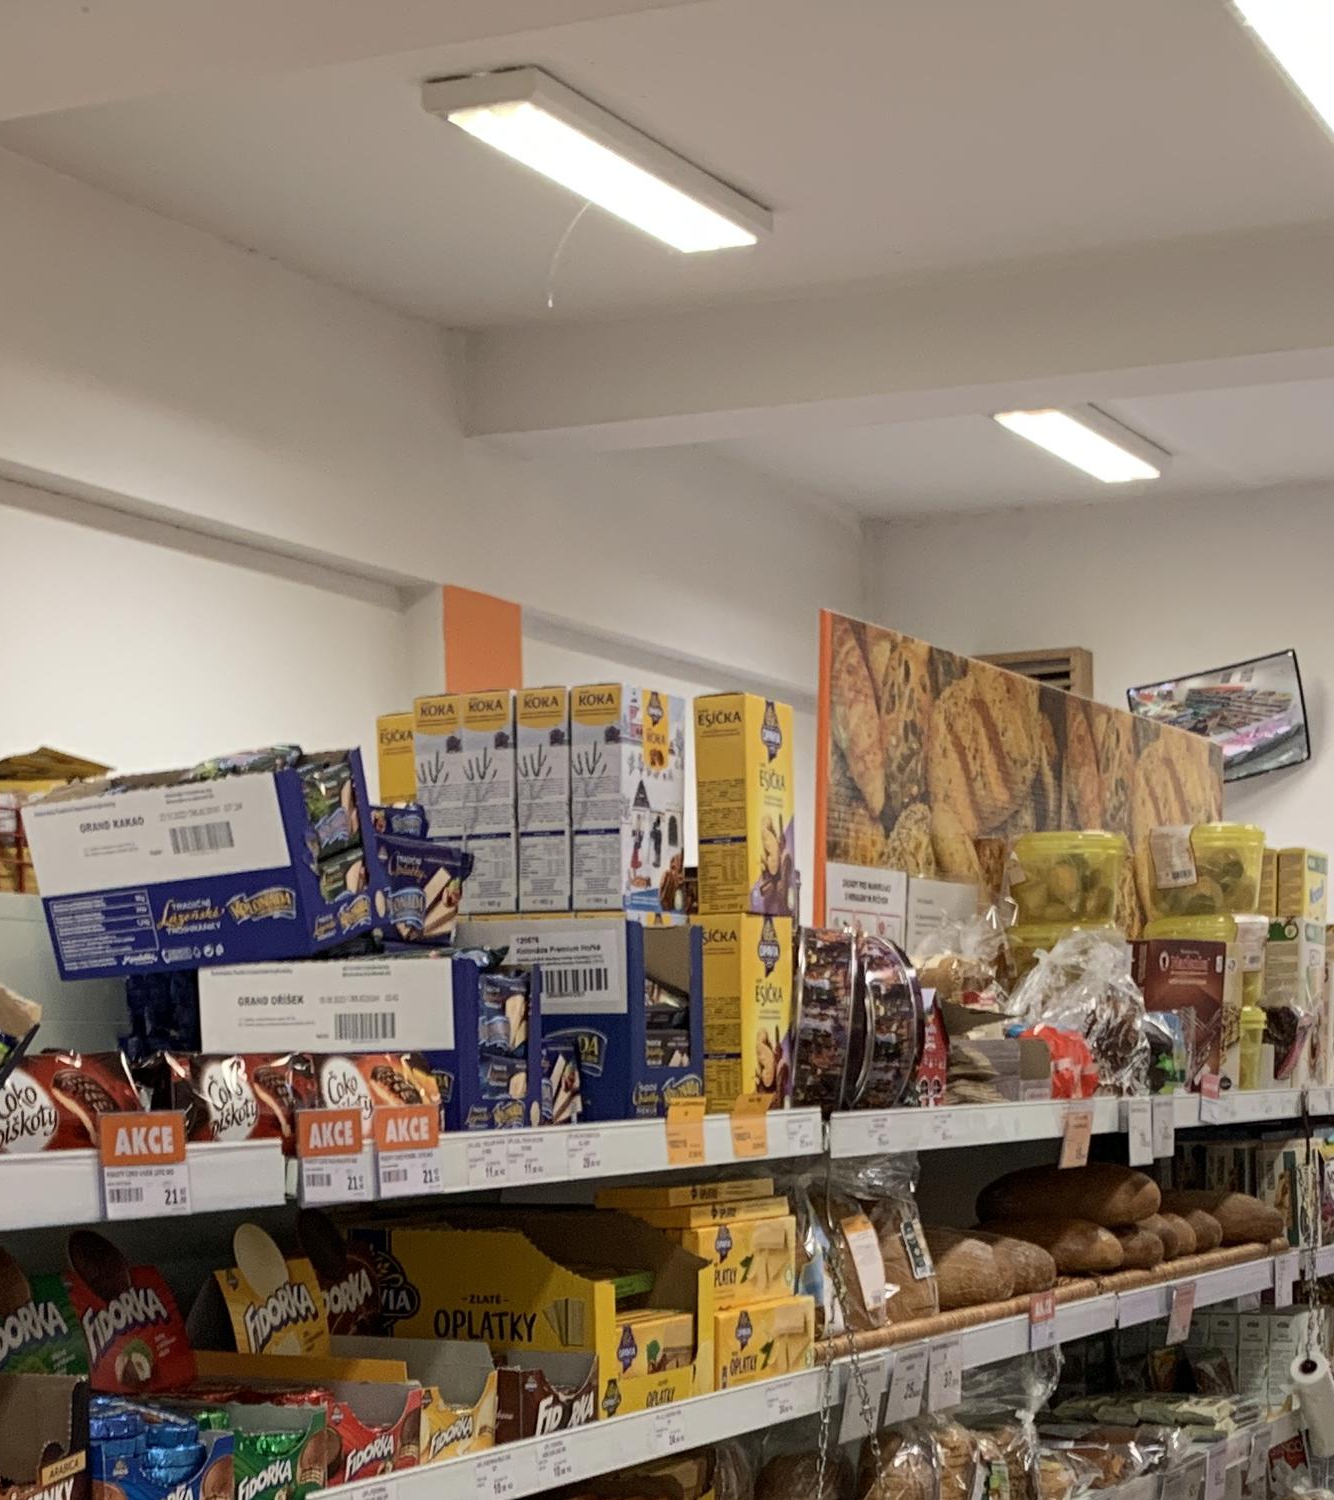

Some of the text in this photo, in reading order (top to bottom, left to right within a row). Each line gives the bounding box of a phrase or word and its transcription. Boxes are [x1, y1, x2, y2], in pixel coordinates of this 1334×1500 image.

[209, 1103, 260, 1140] piškoty
[308, 1120, 355, 1149] AKCE
[384, 1115, 430, 1143] AKCE
[114, 1124, 174, 1157] AKCE
[83, 1286, 168, 1357] FIDORKA
[245, 1282, 316, 1354] FIDORKA
[433, 1309, 538, 1344] OPLATKY
[429, 1414, 475, 1460] FIDORKA
[345, 1432, 395, 1481] FIDORKA
